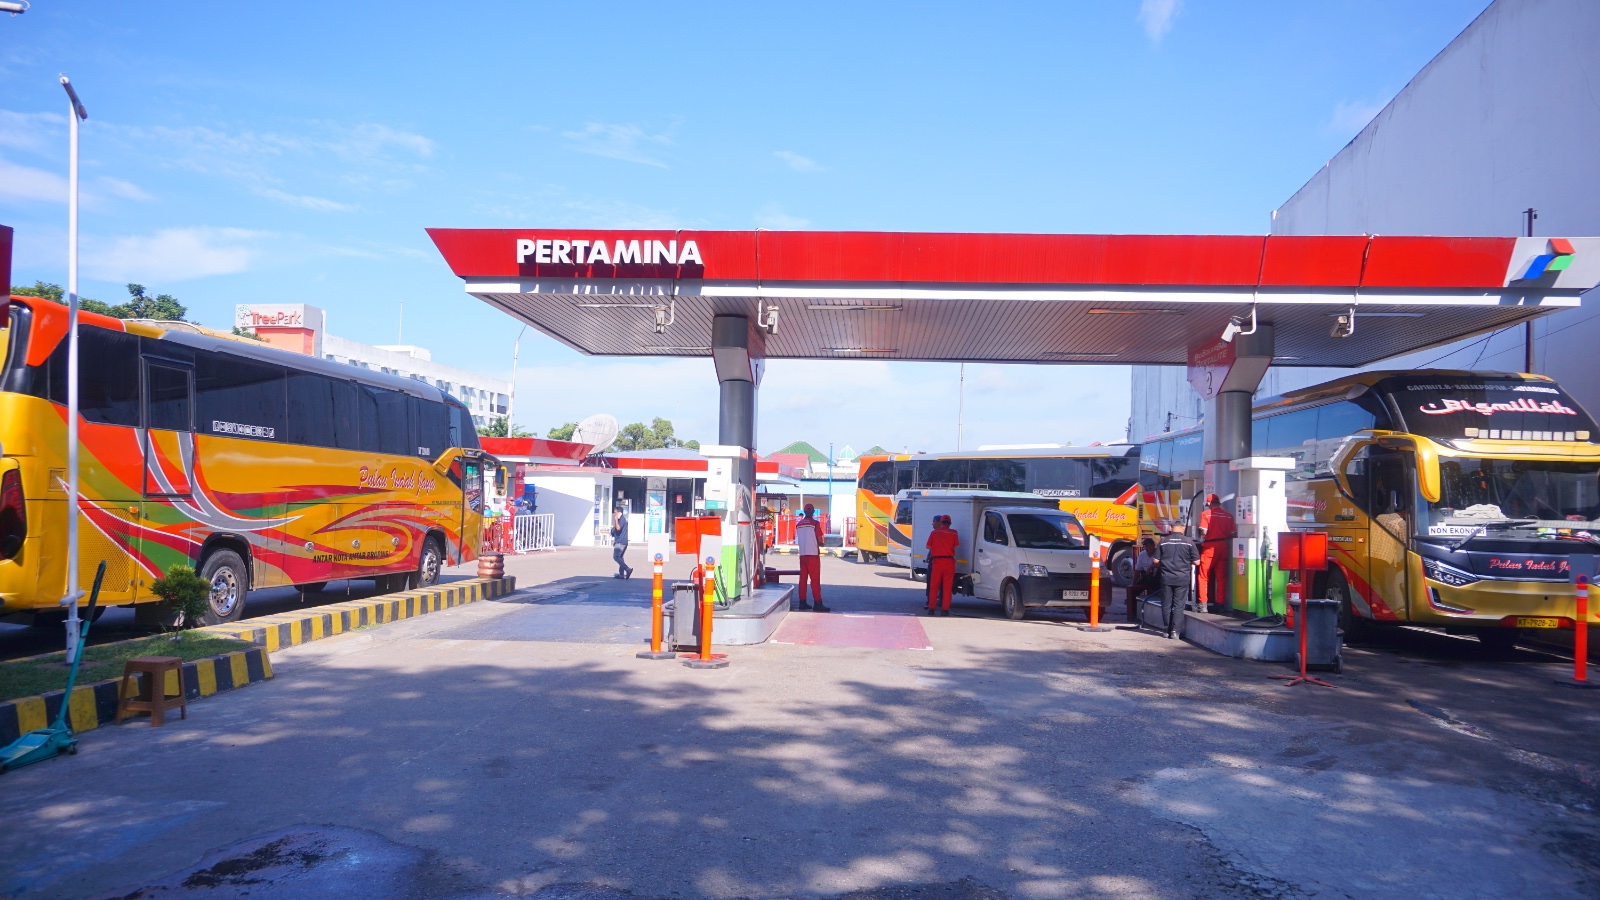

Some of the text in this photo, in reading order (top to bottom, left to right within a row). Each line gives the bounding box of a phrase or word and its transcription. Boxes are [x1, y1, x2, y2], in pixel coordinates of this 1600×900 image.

[516, 239, 704, 265] PERTAMINA
[250, 311, 301, 325] TreePark
[359, 466, 436, 498] Pulau Indah Jaya
[1073, 508, 1127, 523] Indah Jaya
[1450, 527, 1485, 535] EKONOI
[312, 555, 333, 564] ANTAR
[333, 553, 348, 562] KOTA
[348, 552, 366, 560] ANTAR
[1489, 558, 1571, 573] Pulau Indah Ja
